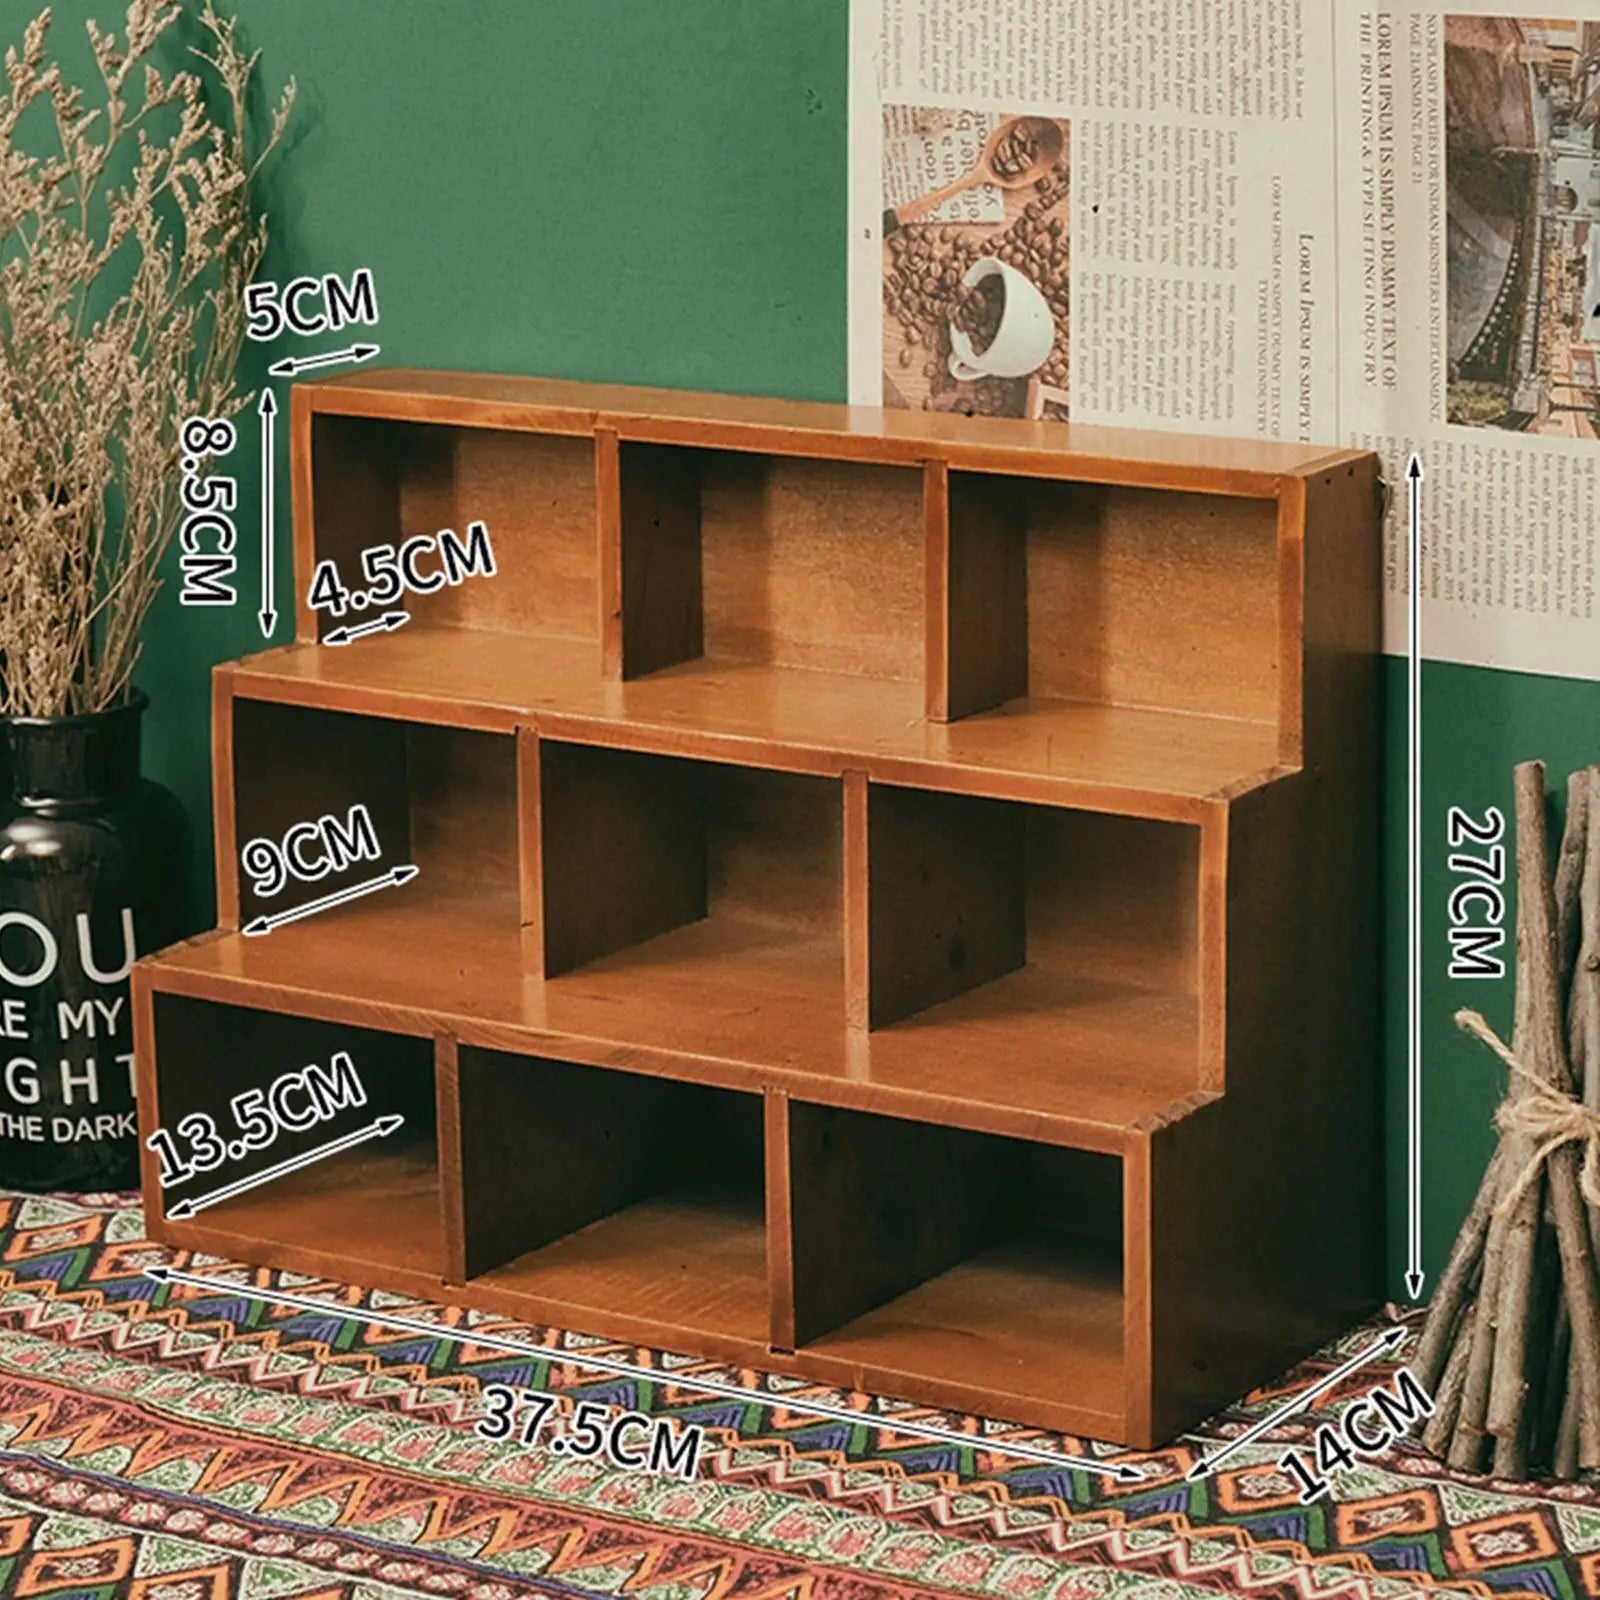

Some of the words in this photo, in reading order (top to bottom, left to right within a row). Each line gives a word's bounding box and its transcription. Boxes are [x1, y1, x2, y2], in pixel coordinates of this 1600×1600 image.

[1360, 12, 1372, 43] THE
[1377, 12, 1392, 79] LOREM
[1410, 13, 1421, 46] PAGE
[1360, 53, 1373, 141] PRINTING
[1378, 84, 1393, 141] IPSUM
[1412, 134, 1422, 167] PAGE
[1428, 98, 1439, 153] PARTIES
[1380, 147, 1394, 164] IS
[1380, 167, 1395, 234] SIMPLY
[1362, 166, 1376, 288] TYPESETTING
[1299, 234, 1314, 293] LOREM
[1381, 240, 1396, 312] DUMMY
[1300, 300, 1314, 350] IPSUM
[1364, 294, 1376, 387] INDUSTRY
[1382, 316, 1397, 362] TEXT
[1300, 355, 1311, 370] IS
[1383, 367, 1398, 391] OF
[1300, 374, 1311, 430] SIMPLY
[57, 997, 124, 1040] MY
[53, 1111, 137, 1143] DARK
